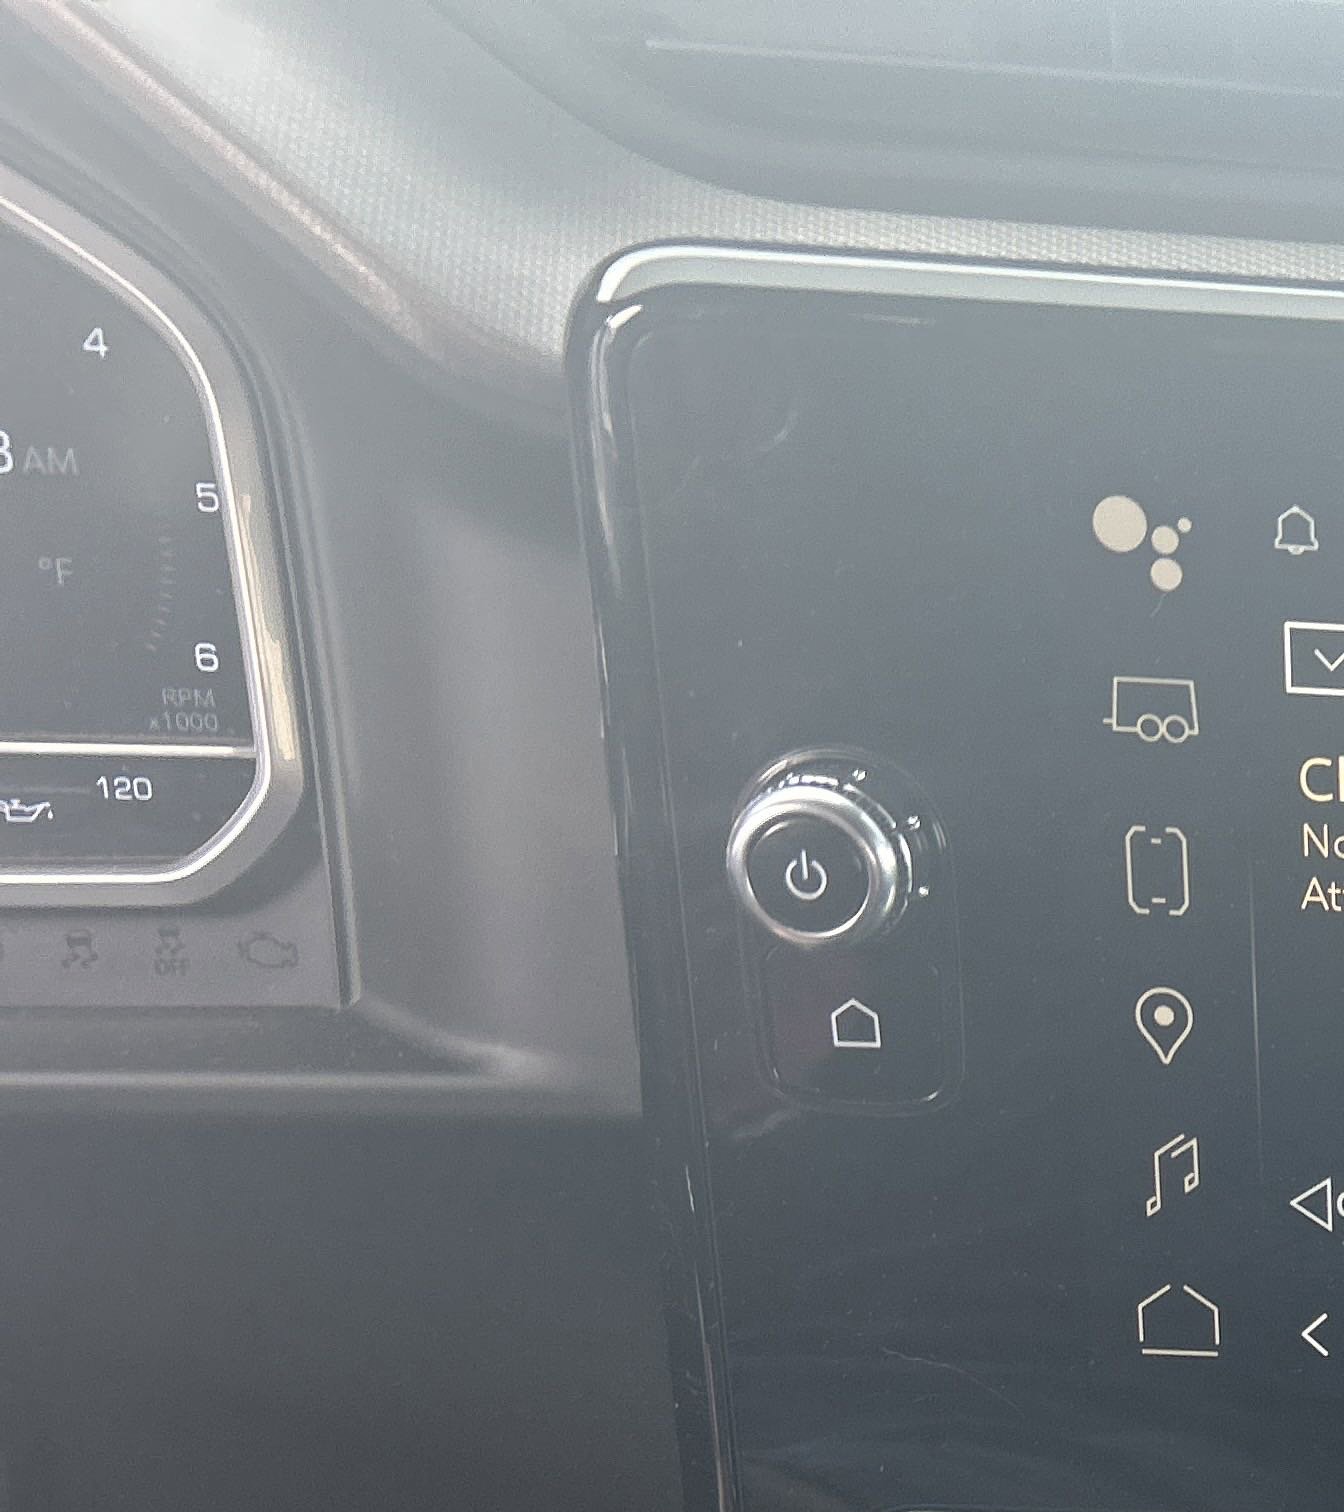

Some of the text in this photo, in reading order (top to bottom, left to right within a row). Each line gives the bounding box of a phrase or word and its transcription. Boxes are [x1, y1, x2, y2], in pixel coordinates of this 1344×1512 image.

[83, 327, 109, 358] 4
[22, 445, 79, 475] AM
[195, 482, 219, 513] 5
[194, 642, 219, 673] 6
[161, 687, 216, 707] RPM
[96, 775, 153, 801] 120
